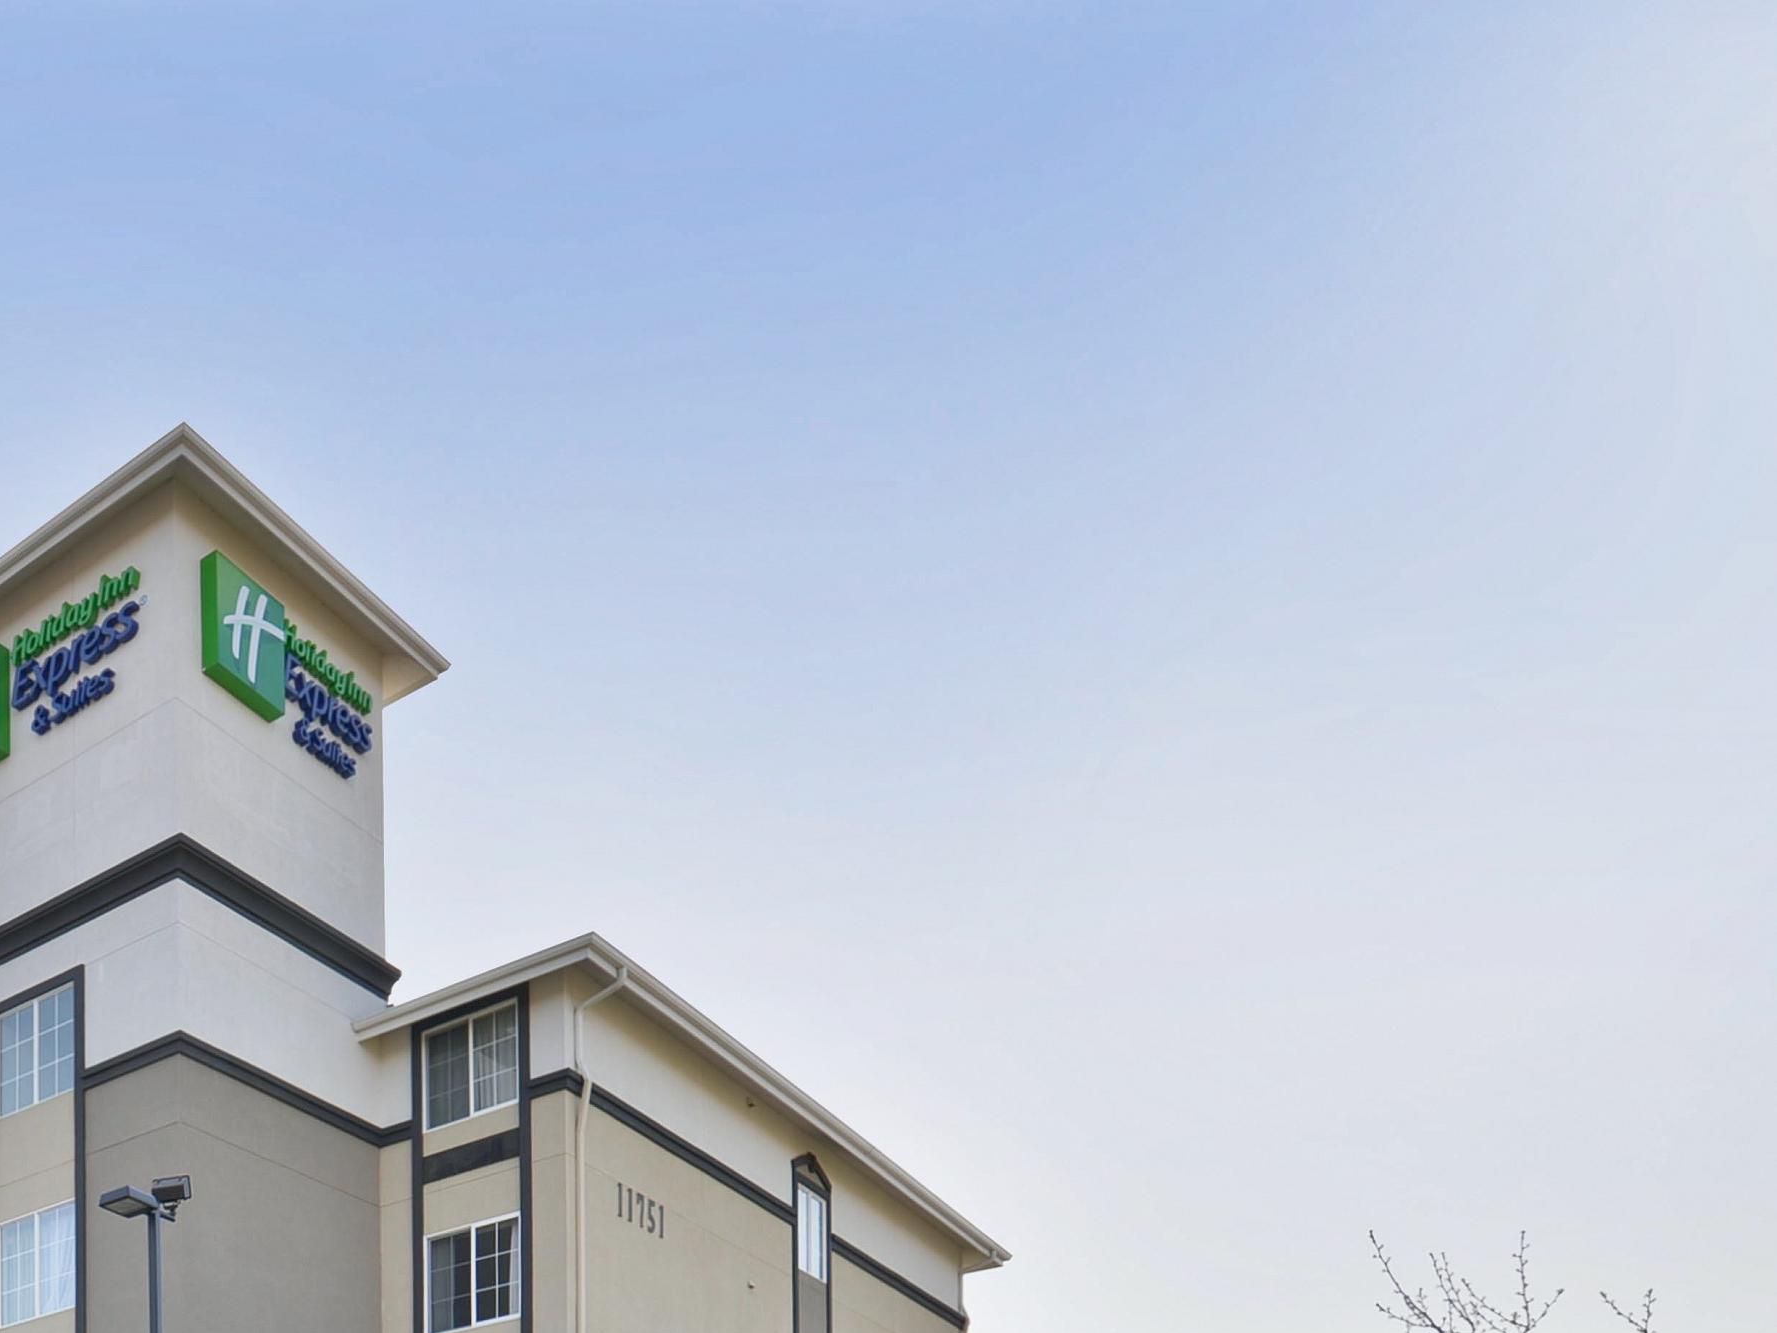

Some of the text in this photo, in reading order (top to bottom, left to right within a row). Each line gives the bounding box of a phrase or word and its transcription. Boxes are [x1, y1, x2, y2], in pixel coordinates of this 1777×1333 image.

[12, 565, 141, 667] Holiday Inn
[12, 601, 140, 711] Express
[31, 668, 116, 736] & Suites
[284, 619, 372, 716] Holiday Inn
[285, 650, 372, 754] Express
[292, 719, 357, 779] & Suites
[616, 1182, 664, 1239] 11751
